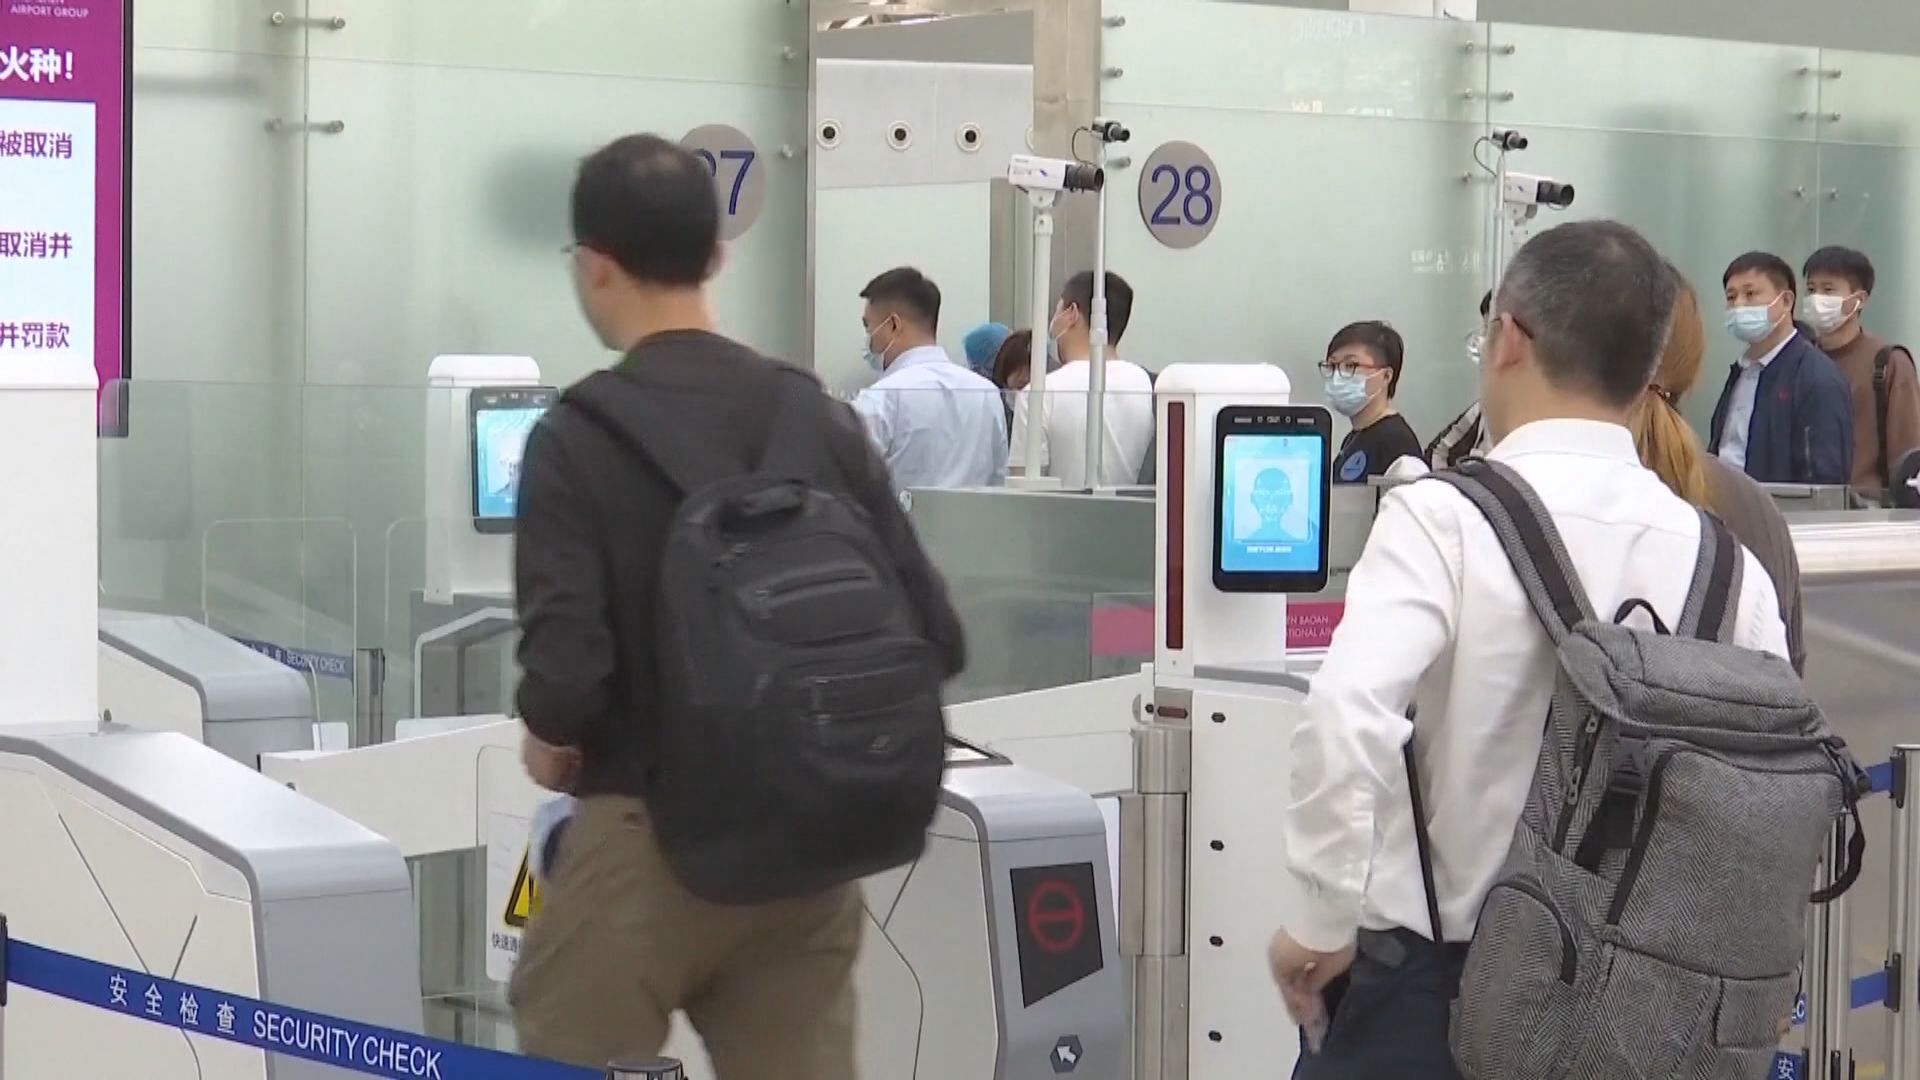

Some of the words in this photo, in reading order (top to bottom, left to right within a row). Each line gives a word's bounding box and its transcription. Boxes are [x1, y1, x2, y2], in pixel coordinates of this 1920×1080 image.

[10, 4, 51, 16] AIRPORT
[53, 6, 89, 18] GROUP
[0, 130, 72, 159] 被取消
[694, 148, 755, 215] 7
[1151, 164, 1213, 226] 28
[109, 972, 237, 1036] 安全检查
[253, 1009, 360, 1062] SECURITY
[362, 1035, 442, 1080] CHECK
